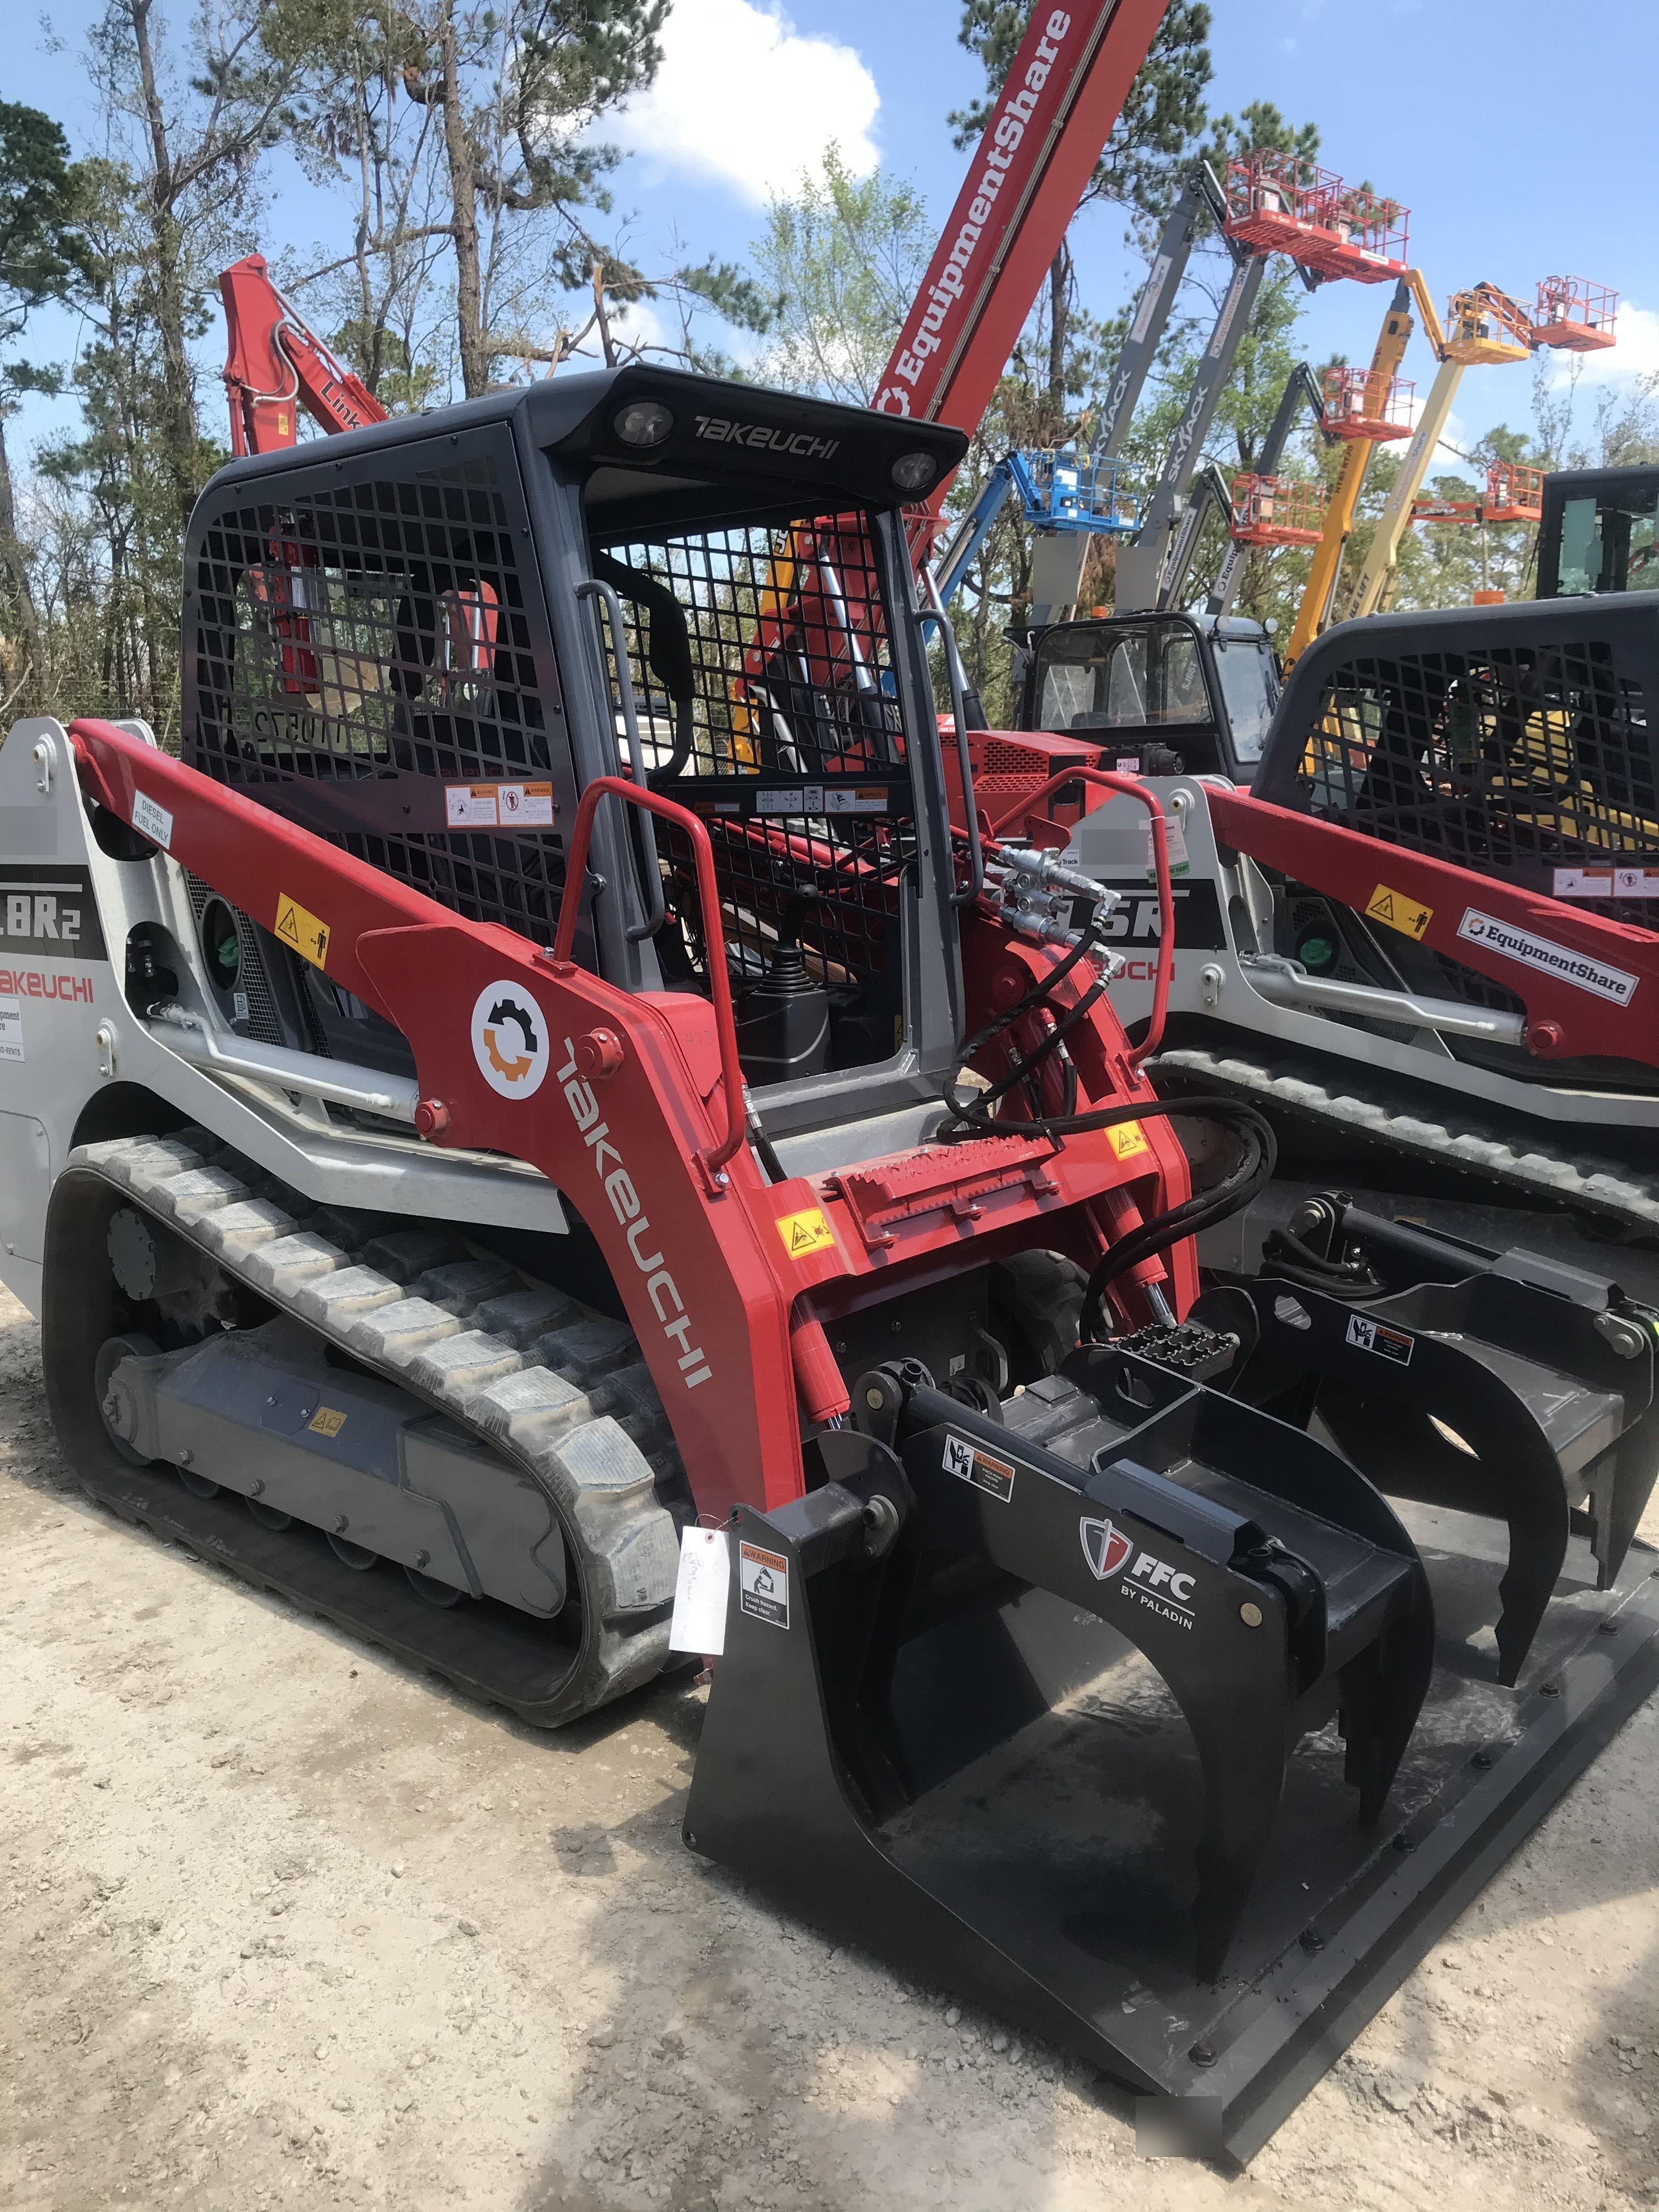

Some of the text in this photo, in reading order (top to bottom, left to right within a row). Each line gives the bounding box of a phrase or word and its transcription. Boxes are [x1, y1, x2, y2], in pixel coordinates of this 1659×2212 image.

[895, 9, 1071, 386] EquipmentShare
[694, 415, 840, 460] TAKEUCHI
[1167, 386, 1209, 483] SKYJACK
[1167, 513, 1194, 576] EquipmentShare
[1182, 661, 1198, 691] SJ66T
[135, 811, 168, 842] FUEL ONLY
[142, 800, 163, 824] DIESEL
[1176, 865, 1189, 873] RENT
[0, 895, 81, 940] 8R2
[1486, 926, 1627, 995] EquipmentShare
[556, 1037, 713, 1389] TAKEUCHI
[982, 1458, 1010, 1475] WARNING
[749, 1550, 785, 1570] WARNING
[1131, 1552, 1196, 1601] FFC
[745, 1594, 778, 1611] Crush hazard.
[745, 1602, 757, 1611] Keep
[1121, 1585, 1193, 1630] BY PALADIN
